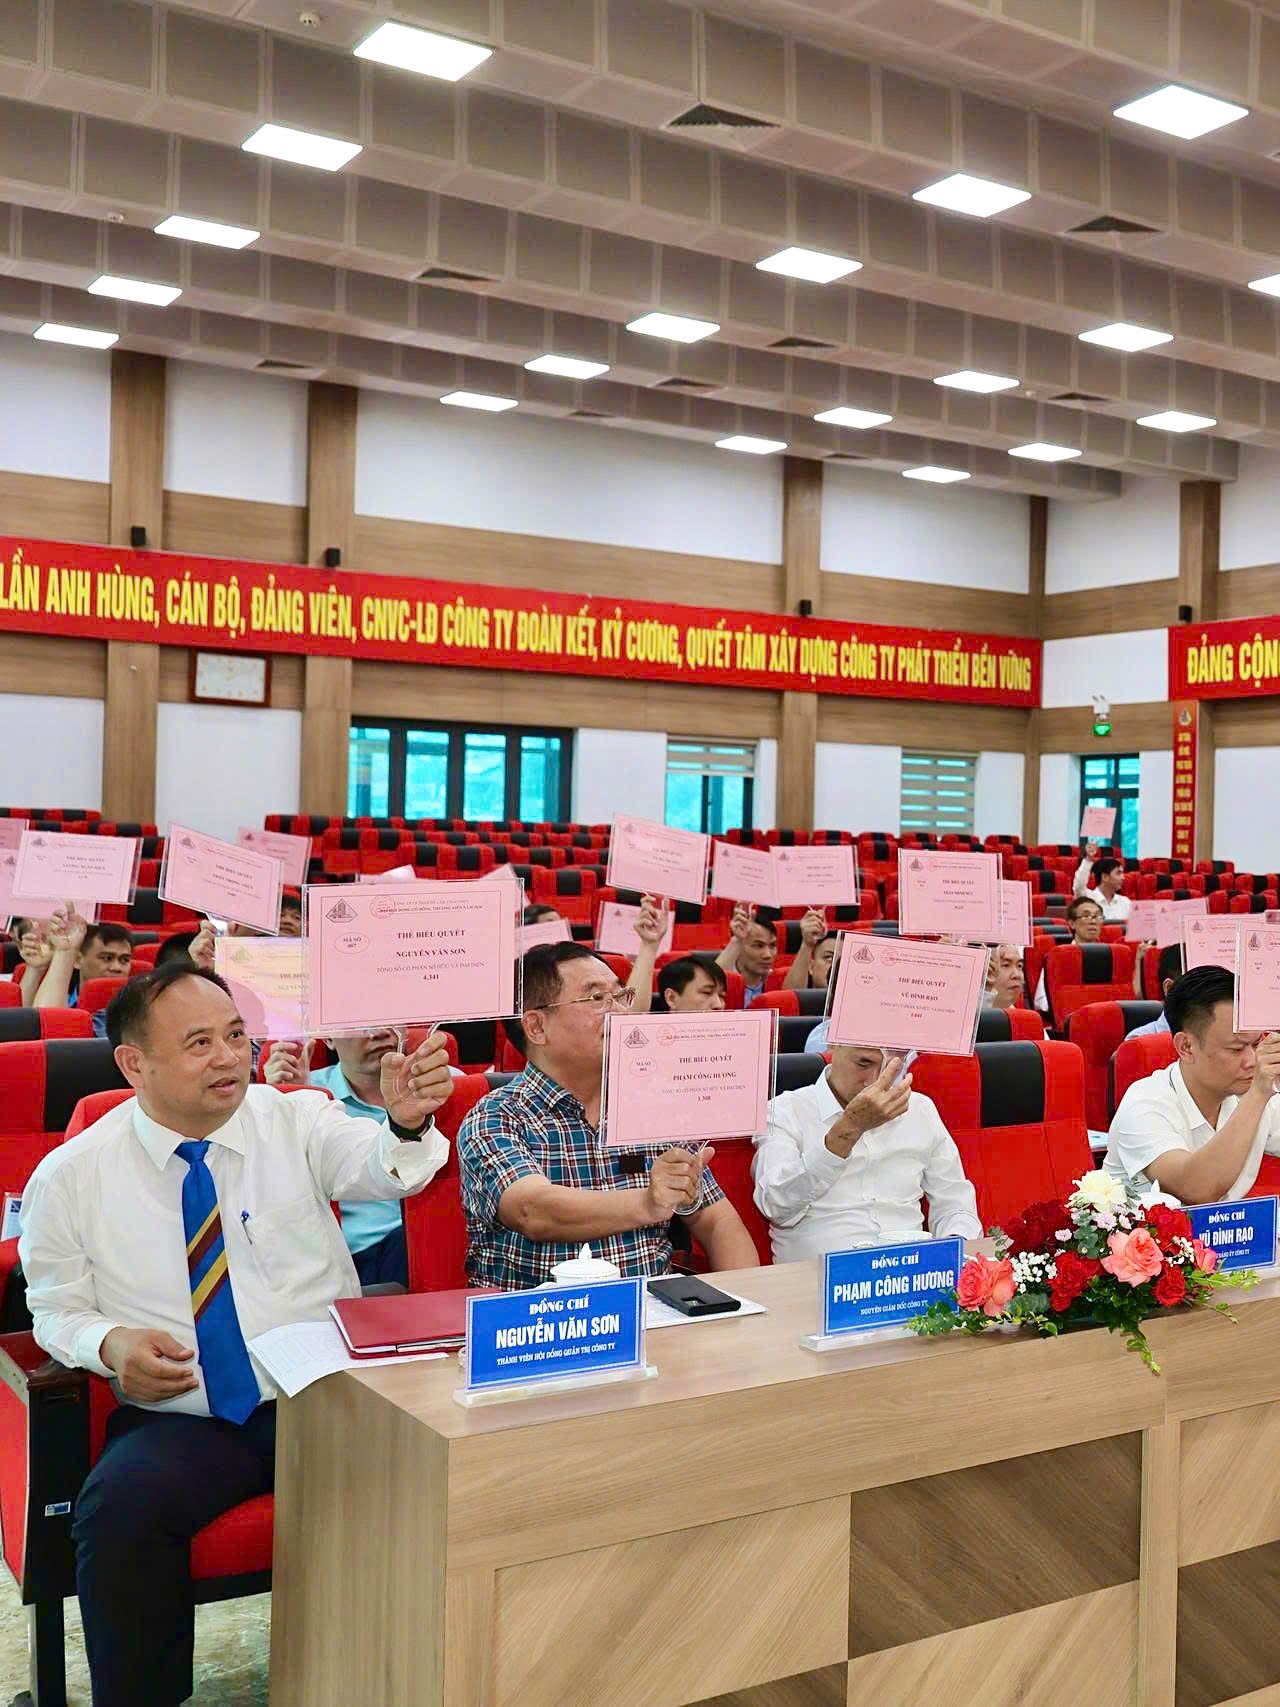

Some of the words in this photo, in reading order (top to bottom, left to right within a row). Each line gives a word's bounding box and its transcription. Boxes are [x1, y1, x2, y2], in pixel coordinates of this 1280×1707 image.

[0, 547, 40, 612] LẦN
[45, 567, 91, 617] ANH
[96, 564, 160, 627] HÙNG,
[165, 571, 209, 627] CÁN
[213, 575, 246, 639] BỘ,
[250, 573, 305, 634] ĐẢNG
[308, 584, 357, 644] VIÊN,
[361, 596, 439, 645] CNVC-LĐ
[441, 596, 490, 649] CÔNG
[493, 608, 515, 651] TY
[516, 604, 563, 654] ĐOÀN
[685, 618, 733, 670] QUYẾT
[734, 624, 767, 671] TÂM
[768, 628, 798, 673] XÂY
[839, 634, 877, 680] CÔNG
[879, 644, 896, 681] TY
[897, 640, 931, 684] PHÁT
[1187, 633, 1234, 684] ĐẢNG
[397, 929, 414, 939] THẺ
[416, 928, 434, 938] BIỂU
[437, 927, 466, 938] QUYẾT
[395, 948, 430, 958] NGUYỄN
[431, 947, 449, 956] VĂN
[450, 946, 466, 955] SƠN
[710, 1053, 732, 1063] QUYẾT
[673, 1074, 692, 1082] PHẠM
[693, 1072, 712, 1080] CÔNG
[1208, 1210, 1230, 1224] ĐỒNG
[1231, 1208, 1246, 1221] CHÍ
[1213, 1227, 1234, 1246] ĐÌNH
[1236, 1226, 1254, 1245] RẠO
[871, 1254, 899, 1270] ĐỒNG
[901, 1251, 919, 1265] CHÍ
[833, 1280, 872, 1304] PHẠM
[875, 1275, 910, 1297] CÔNG
[912, 1269, 954, 1292] HƯƠNG
[529, 1298, 565, 1315] ĐỒNG
[566, 1294, 590, 1311] CHÍ
[495, 1317, 555, 1349] NGUYỄN
[558, 1316, 587, 1340] VĂN
[591, 1314, 620, 1337] SƠN
[496, 1355, 518, 1366] THÀNH
[518, 1352, 534, 1363] VIÊN
[534, 1351, 545, 1362] HỘI
[546, 1347, 563, 1359] ĐỒNG
[563, 1346, 580, 1357] QUẢN
[580, 1346, 591, 1355] TRỊ
[591, 1342, 607, 1353] CÔNG
[607, 1342, 616, 1351] TY
